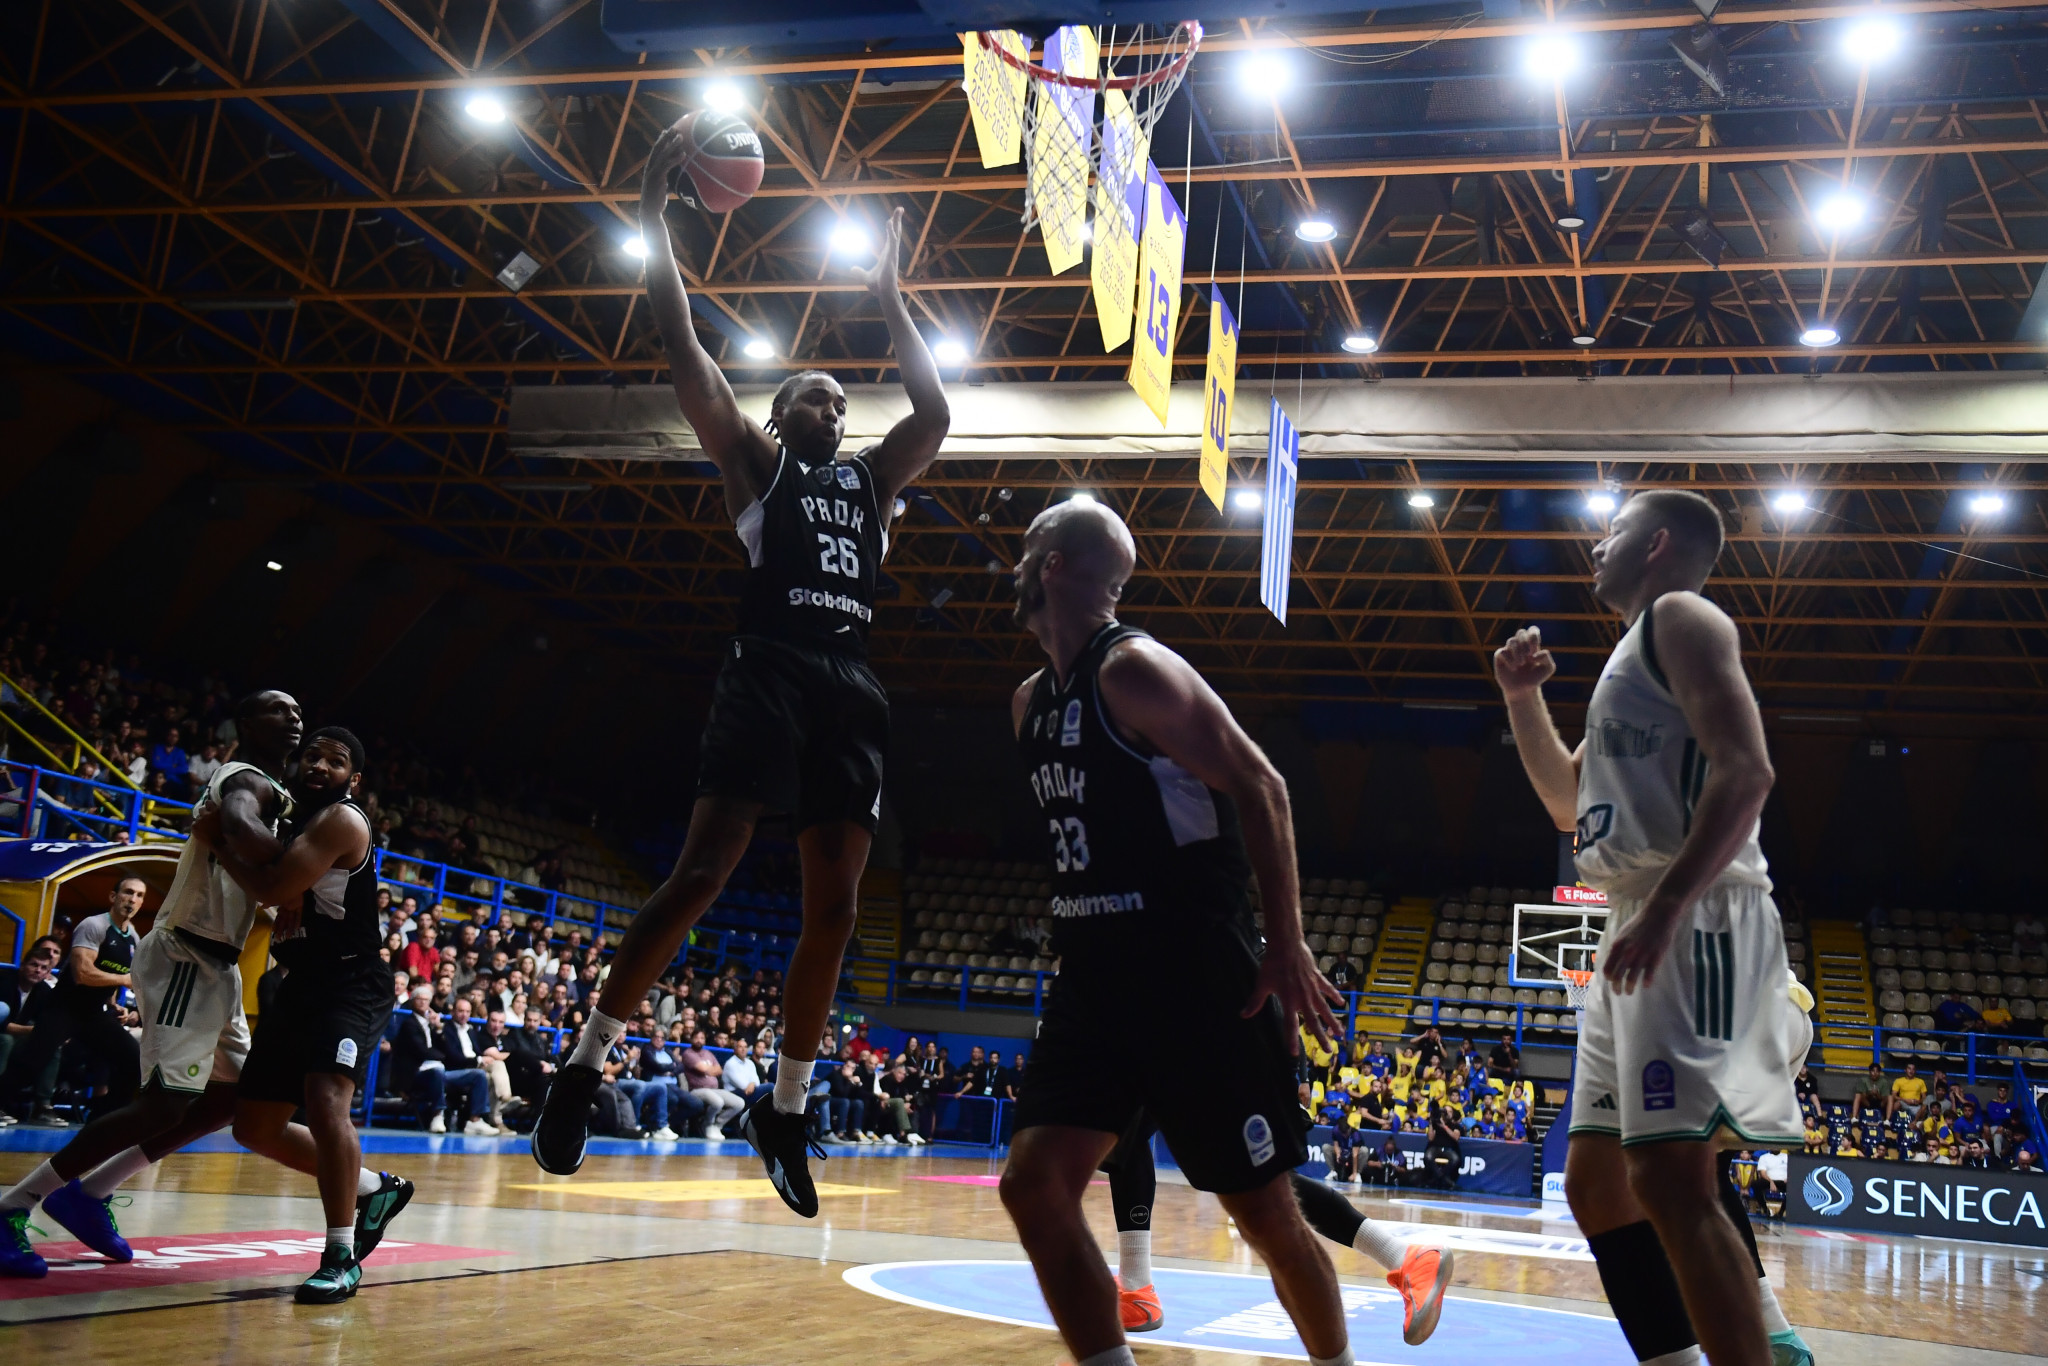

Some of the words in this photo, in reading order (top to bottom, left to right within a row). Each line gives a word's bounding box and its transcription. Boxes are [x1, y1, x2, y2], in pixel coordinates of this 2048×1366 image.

[1147, 266, 1170, 357] 13
[1210, 374, 1226, 453] 10
[801, 495, 865, 534] PAOK
[817, 533, 860, 579] 26
[1031, 762, 1085, 808] PAOK
[1050, 816, 1090, 872] 33
[1865, 1177, 2046, 1229] SENECA
